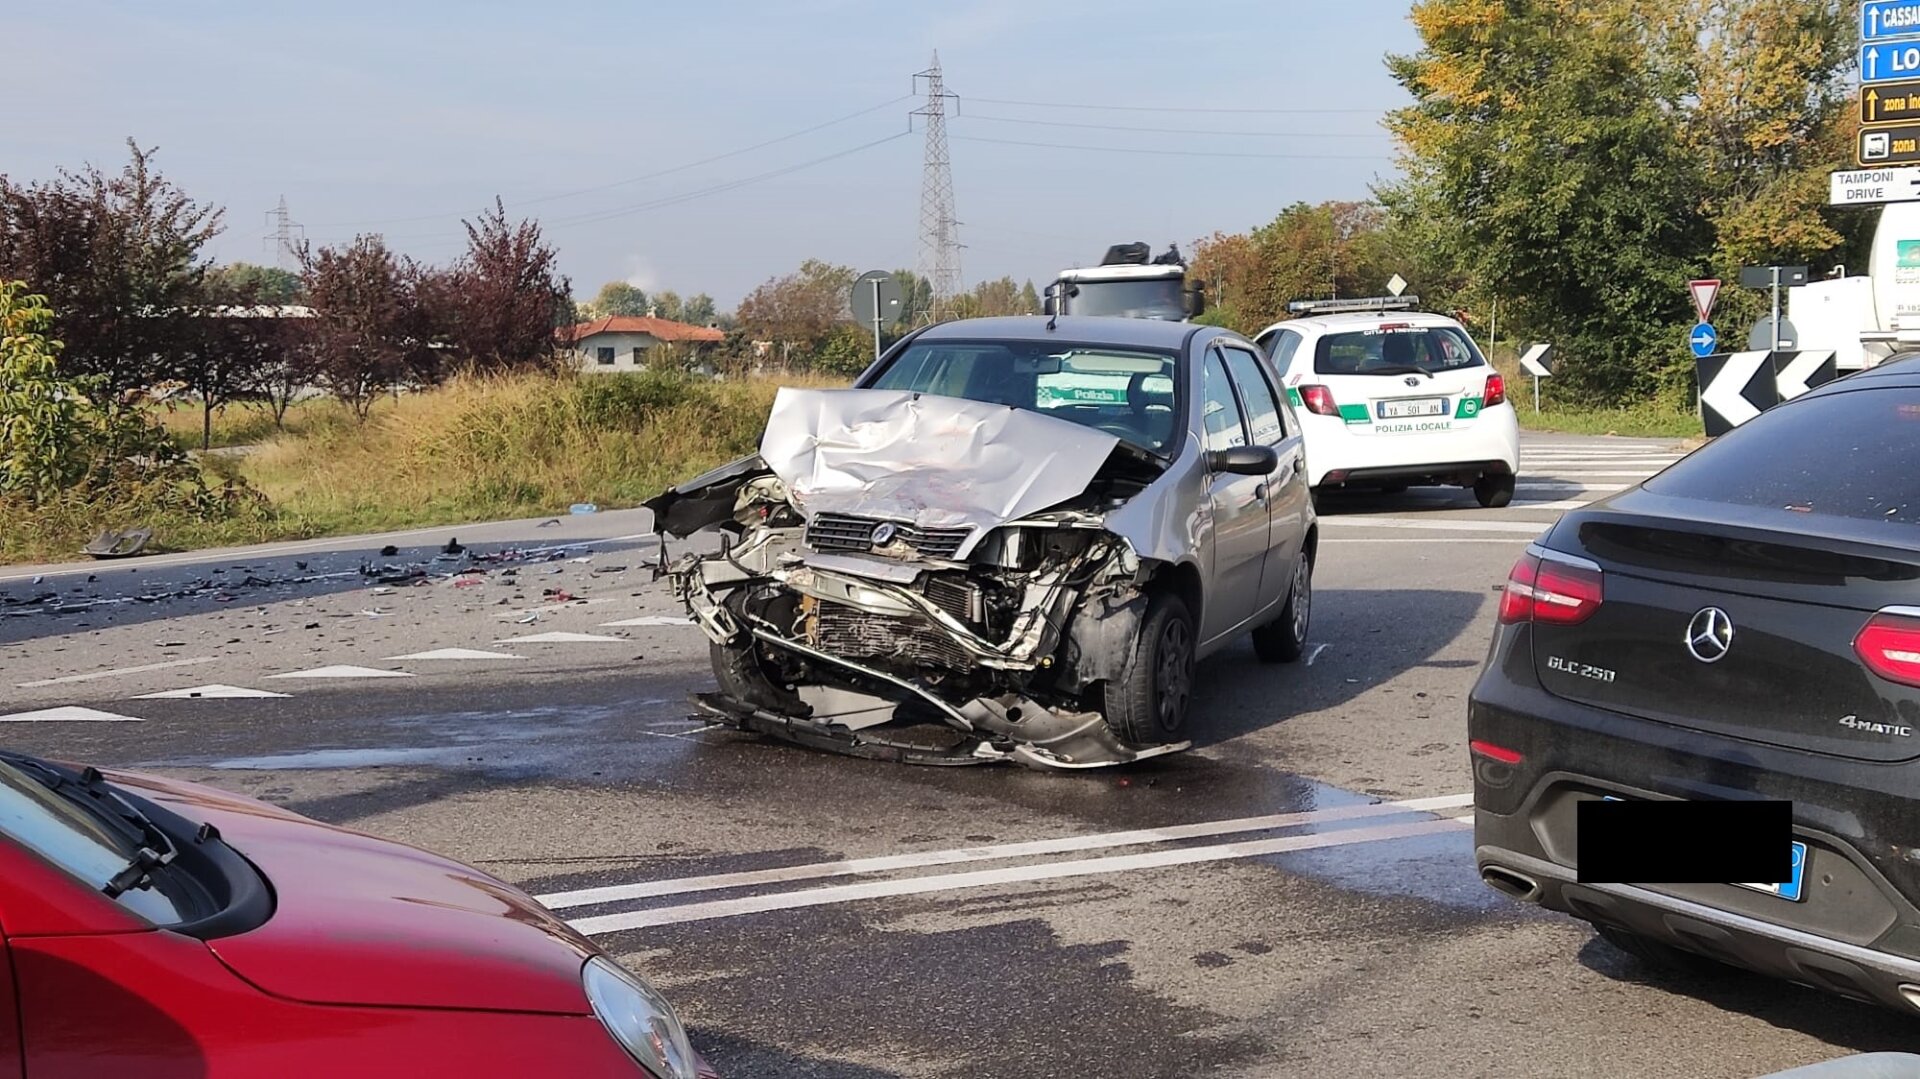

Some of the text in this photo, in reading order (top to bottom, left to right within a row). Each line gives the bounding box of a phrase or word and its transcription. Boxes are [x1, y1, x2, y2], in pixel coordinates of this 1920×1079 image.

[1884, 97, 1906, 111] zona
[1892, 139, 1916, 153] zona
[1838, 171, 1894, 184] TAMPONI
[1846, 187, 1884, 200] DRIVE
[1074, 389, 1114, 400] Polizia
[1389, 404, 1439, 416] YA 501 AN
[1375, 421, 1452, 433] POLIZIA LOCALE
[1547, 655, 1616, 683] GLC 250
[1839, 715, 1911, 737] 4MATIC
